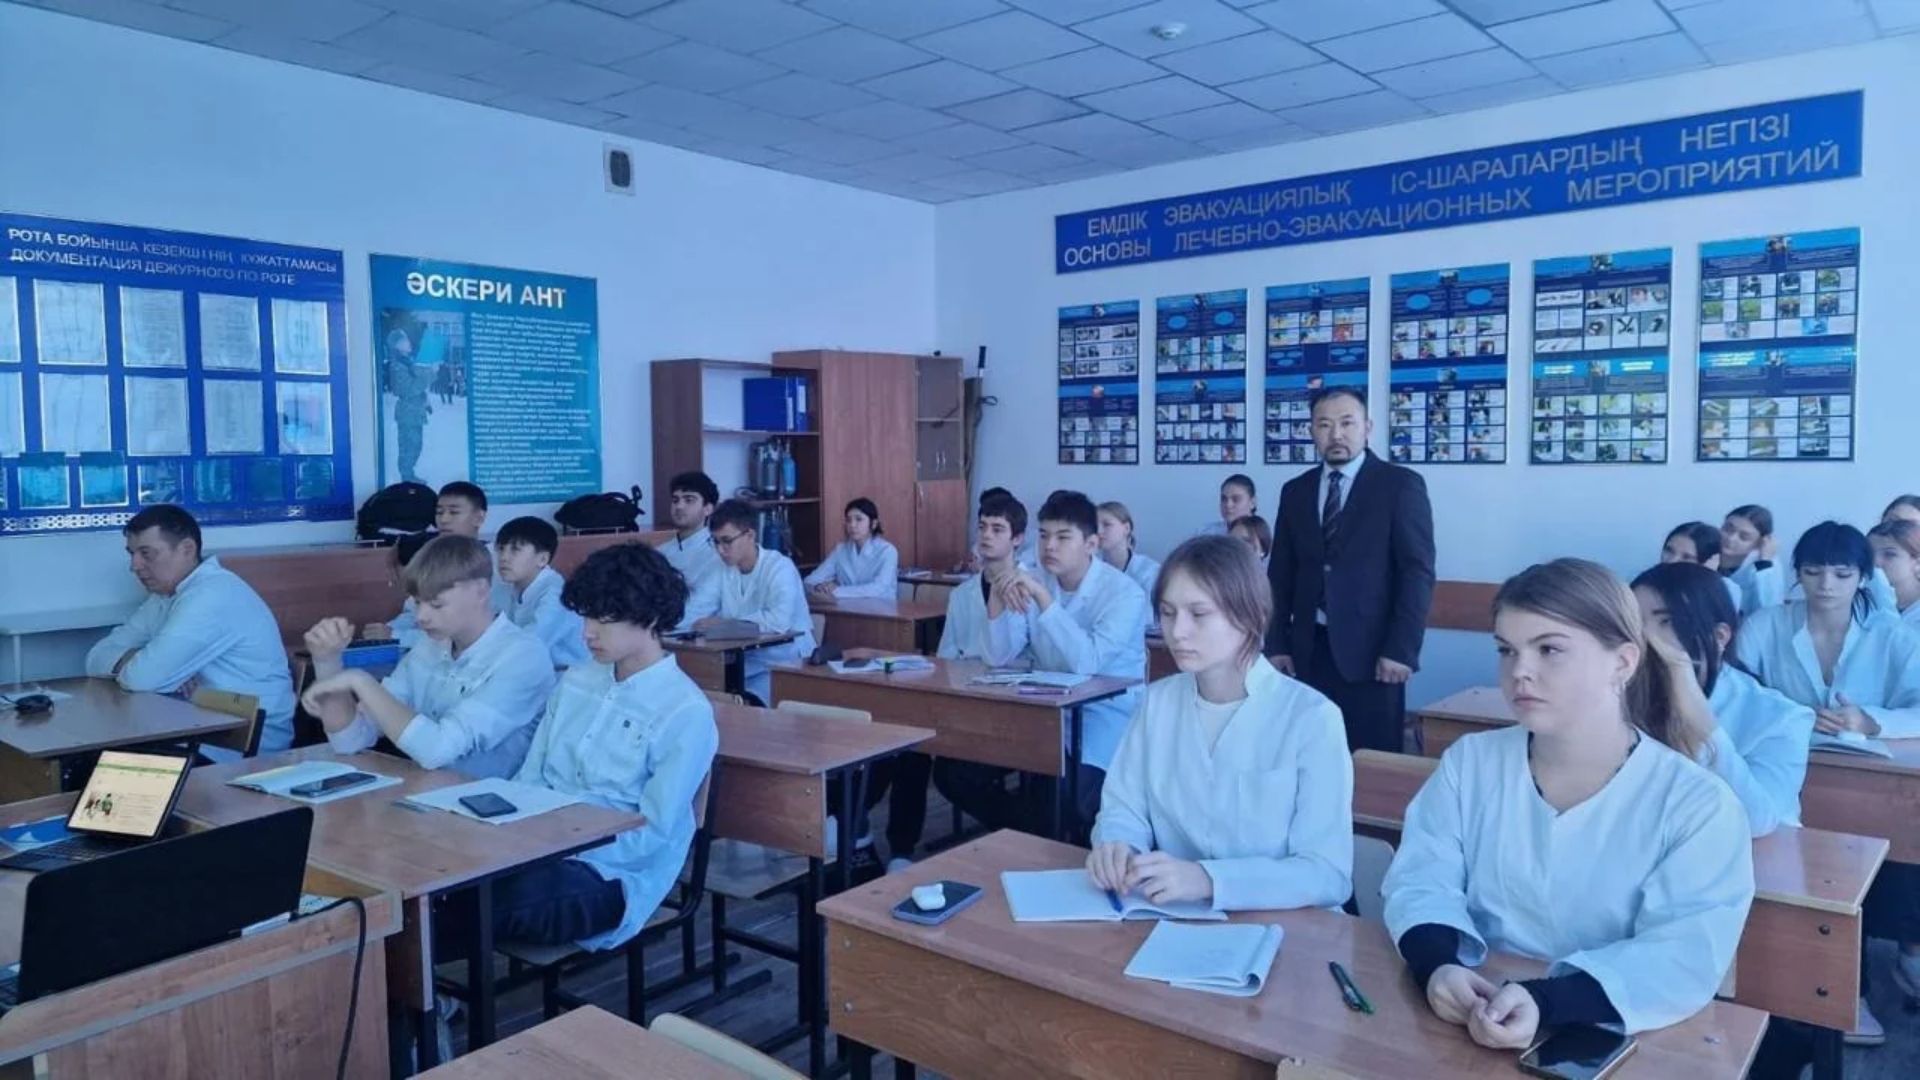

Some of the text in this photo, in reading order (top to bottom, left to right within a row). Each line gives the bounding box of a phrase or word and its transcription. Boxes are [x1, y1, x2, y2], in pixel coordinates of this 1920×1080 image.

[1088, 113, 1790, 238] ЕМДІК ЭВАКУАЦИЯЛЫҚ ІС-ШАРАЛАРДЫҢ НЕГІЗІ
[1064, 139, 1840, 267] ОСНОВЫ ЛЕЧЕБНО-ЭВАКУАЦИОННЫХ МЕРОПРИЯТИЙ
[8, 228, 53, 245] РОТА
[57, 234, 140, 252] БОЙЫНША
[10, 248, 297, 286] ДОКУМЕНТАЦИЯ ДЕЖУРНОГО ПО РОТЕ
[406, 272, 567, 309] ӘСКЕРИ АНТ
